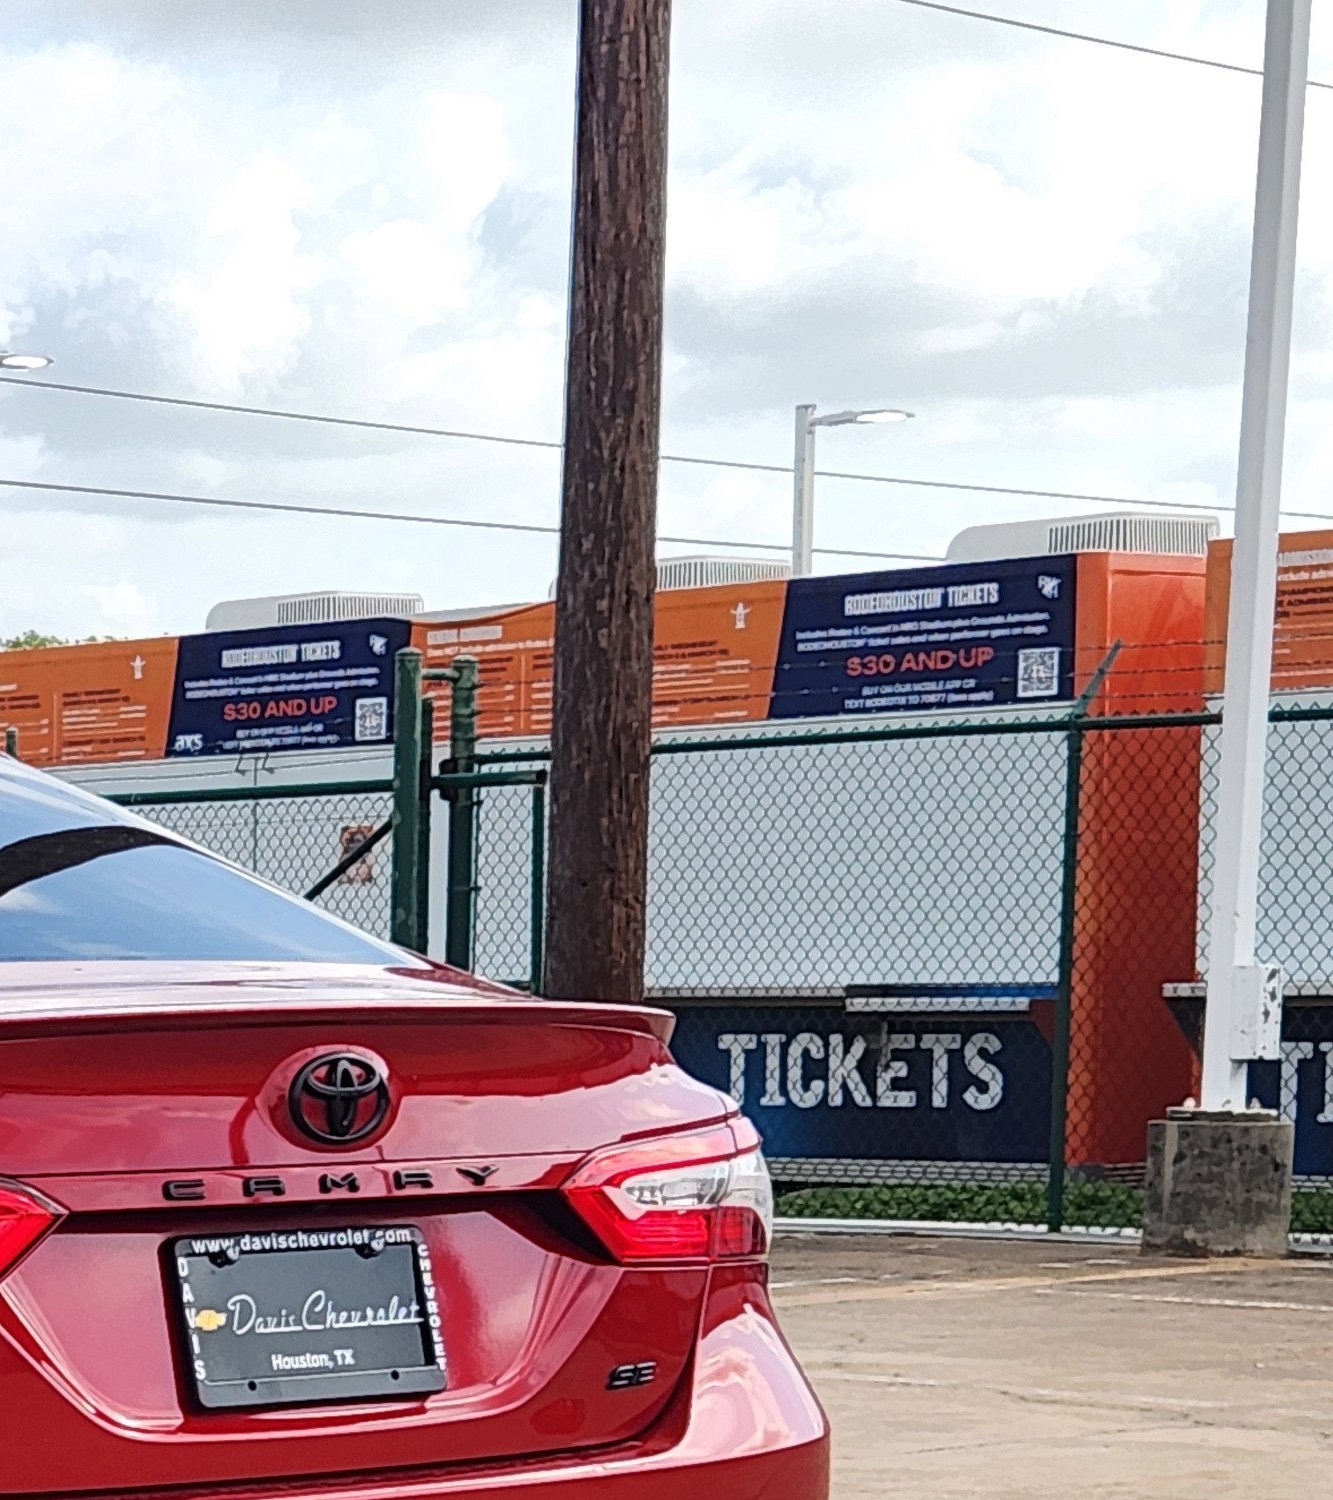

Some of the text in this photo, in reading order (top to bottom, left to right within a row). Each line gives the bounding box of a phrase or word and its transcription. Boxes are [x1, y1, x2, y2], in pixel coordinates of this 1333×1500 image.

[900, 650, 954, 672] AND
[959, 647, 995, 668] UP
[264, 698, 307, 718] AND
[309, 696, 338, 714] UP
[717, 1032, 1004, 1111] TICKETS
[162, 1163, 500, 1200] CAMRY
[191, 1229, 413, 1255] wwwdavischevroletcom
[177, 1257, 206, 1381] DAVIS
[301, 1289, 425, 1331] Chevrolet
[417, 1243, 448, 1371] CHEVROLET
[271, 1348, 355, 1371] Houston, TX
[608, 1361, 657, 1388] SE
